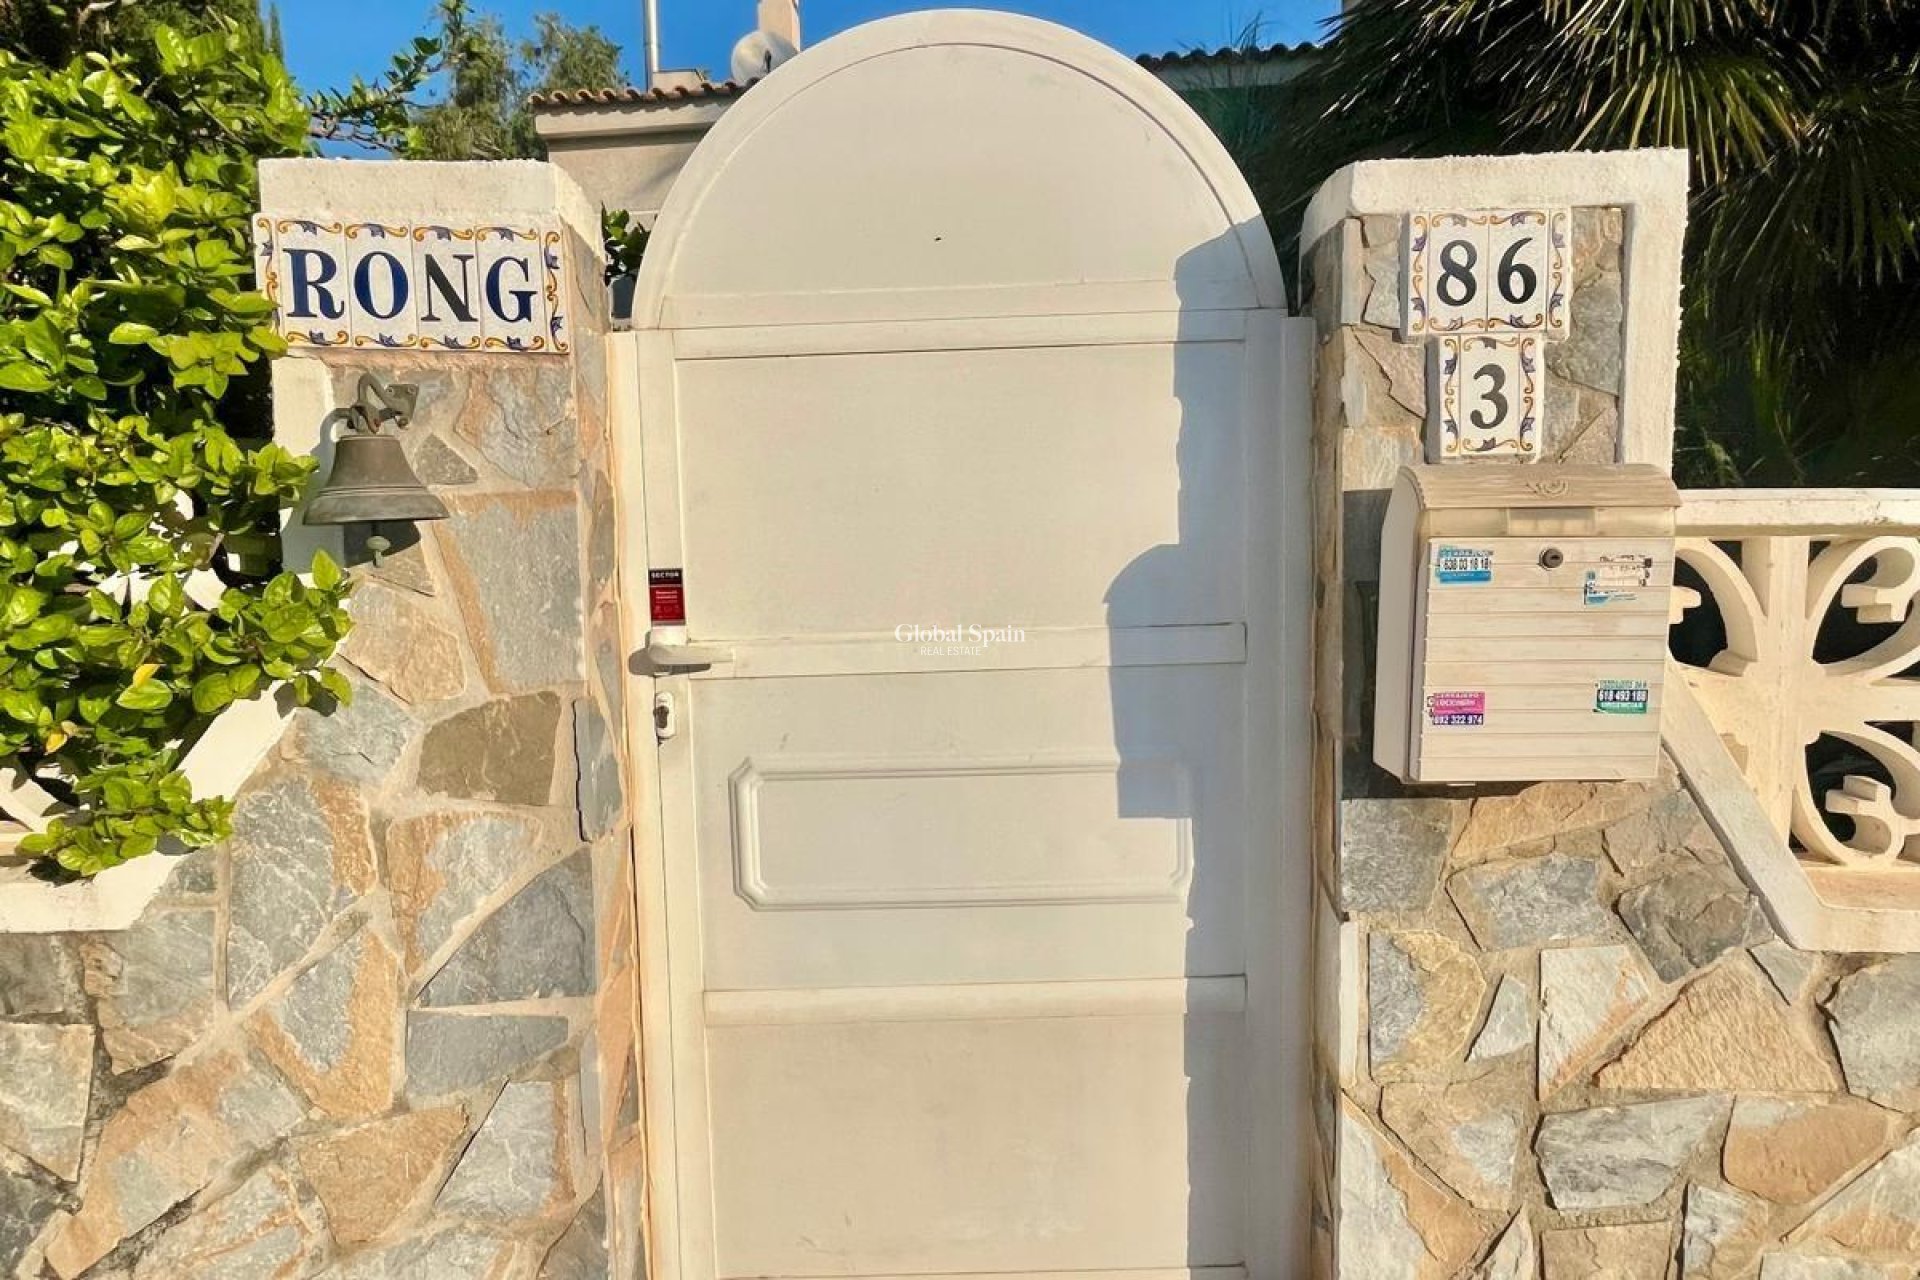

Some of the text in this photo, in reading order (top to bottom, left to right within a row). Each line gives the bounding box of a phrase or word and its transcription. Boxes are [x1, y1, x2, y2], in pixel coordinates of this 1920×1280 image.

[282, 247, 538, 323] RONG
[1436, 237, 1537, 307] 86
[1470, 363, 1508, 430] 3
